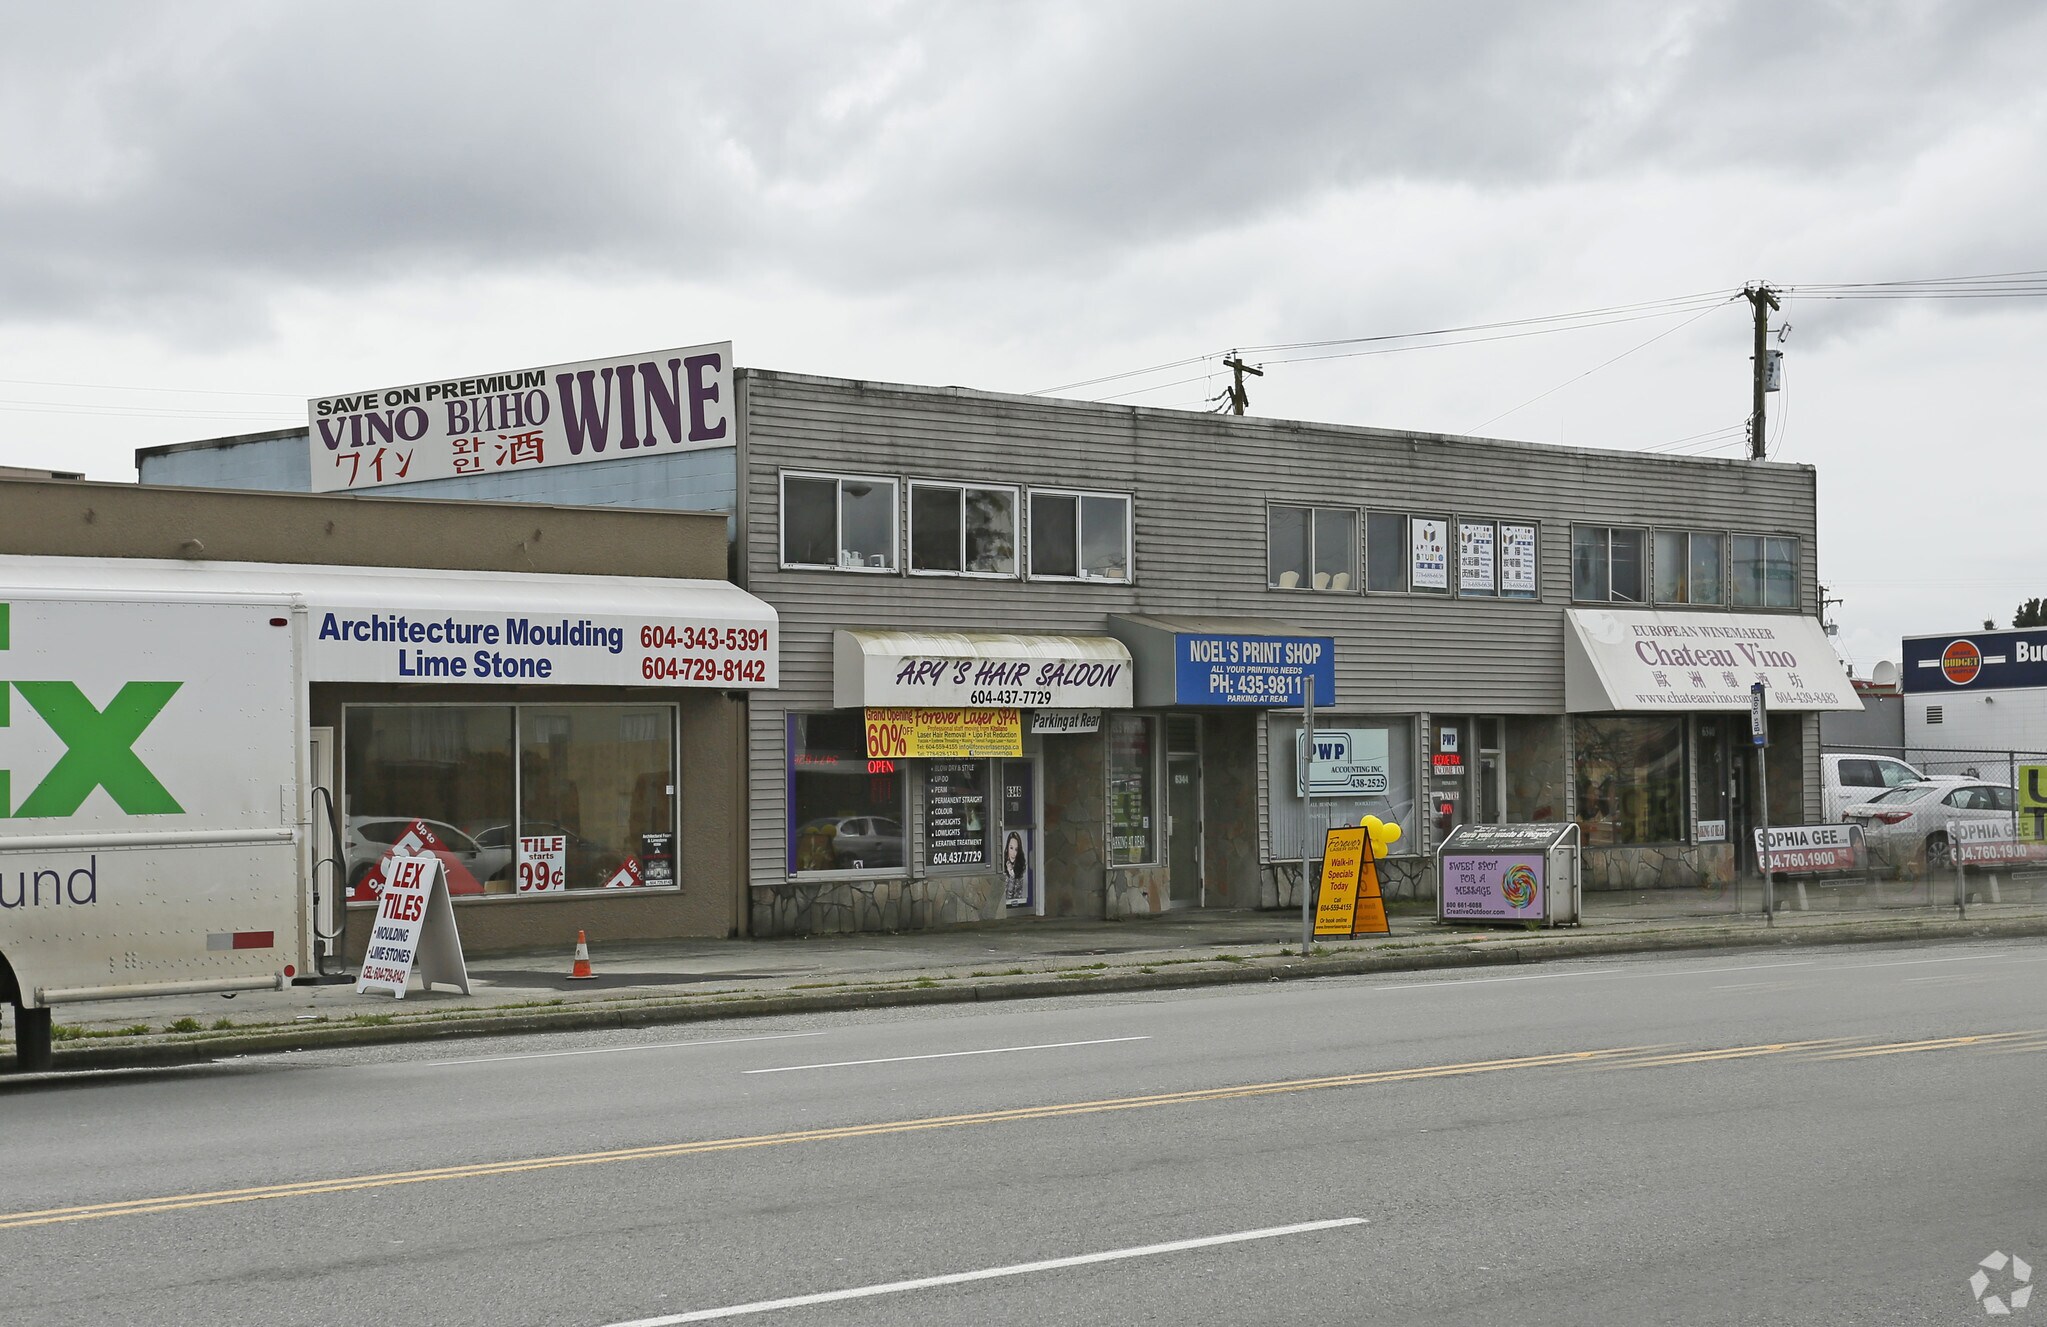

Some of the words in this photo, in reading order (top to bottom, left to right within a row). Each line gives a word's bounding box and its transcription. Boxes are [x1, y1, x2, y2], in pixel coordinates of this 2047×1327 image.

[317, 393, 378, 415] SAVE
[384, 387, 420, 406] ON
[426, 370, 546, 401] PREMIUM
[445, 389, 551, 436] ВИНО
[556, 353, 727, 456] WINE
[316, 406, 429, 450] VINO
[494, 430, 544, 466] 酒
[336, 447, 414, 487] ワイン
[318, 612, 500, 645] Architecture
[506, 618, 624, 654] Moulding
[640, 625, 769, 652] 604-343-5391
[1631, 624, 1698, 637] EUROPEAN
[1698, 626, 1775, 640] WINEMAKER
[1190, 640, 1239, 663] NOEL'S
[1242, 641, 1282, 663] PRINT
[1286, 643, 1321, 664] SHOP
[1635, 639, 1740, 668] Chateau
[1735, 642, 1797, 669] Vino
[398, 649, 467, 678] Lime
[473, 650, 552, 679] Stone
[641, 657, 766, 682] 604-729-8142
[1211, 665, 1224, 673] ALL
[1226, 665, 1245, 673] YOUR
[1246, 666, 1279, 674] PRINTING
[1944, 657, 1979, 668] BUDGET
[974, 660, 1031, 686] HAIR
[1036, 663, 1121, 687] SALOON
[1210, 674, 1233, 693] PH:
[1238, 675, 1301, 694] 435-9811
[971, 690, 1052, 705] 604-437-7729
[1227, 694, 1257, 702] PARKING
[1775, 690, 1839, 704] 604-439-8483
[866, 708, 885, 721] Grand
[887, 708, 913, 724] Opening
[915, 708, 961, 727] Forever
[964, 708, 995, 726] Laser
[997, 708, 1018, 725] SPA
[1033, 713, 1068, 731] Parking
[1069, 714, 1078, 728] at
[1079, 713, 1099, 727] Rear
[903, 726, 914, 735] OFF
[868, 723, 907, 756] 60%
[1442, 734, 1456, 745] PWP
[868, 760, 894, 773] OPEN
[1331, 765, 1370, 774] ACCOUNTING
[1371, 765, 1383, 773] INC.
[1351, 778, 1385, 788] 438-2525
[935, 796, 961, 804] PERMANENT
[416, 821, 427, 835] Up
[426, 832, 435, 844] to
[1757, 830, 1809, 848] SOPHIA
[520, 838, 563, 852] TILE
[1328, 836, 1361, 848] Forever
[933, 851, 982, 864] 604.437.7729
[1331, 858, 1354, 867] Walk-in
[1449, 860, 1475, 871] SWEET
[1478, 860, 1498, 871] SPOT
[392, 861, 425, 889] LEX
[1328, 870, 1354, 880] Specials
[1460, 874, 1476, 884] FOR
[1479, 874, 1486, 883] A
[1330, 882, 1349, 891] Today
[1455, 886, 1491, 897] MESSAGE
[382, 893, 424, 922] TILES
[1320, 903, 1352, 911] 604-559-4155
[375, 926, 409, 942] MOULDING
[370, 945, 386, 960] LIME
[385, 947, 411, 963] STONES
[363, 965, 374, 979] CEL:
[373, 966, 406, 983] 604-729-8142
